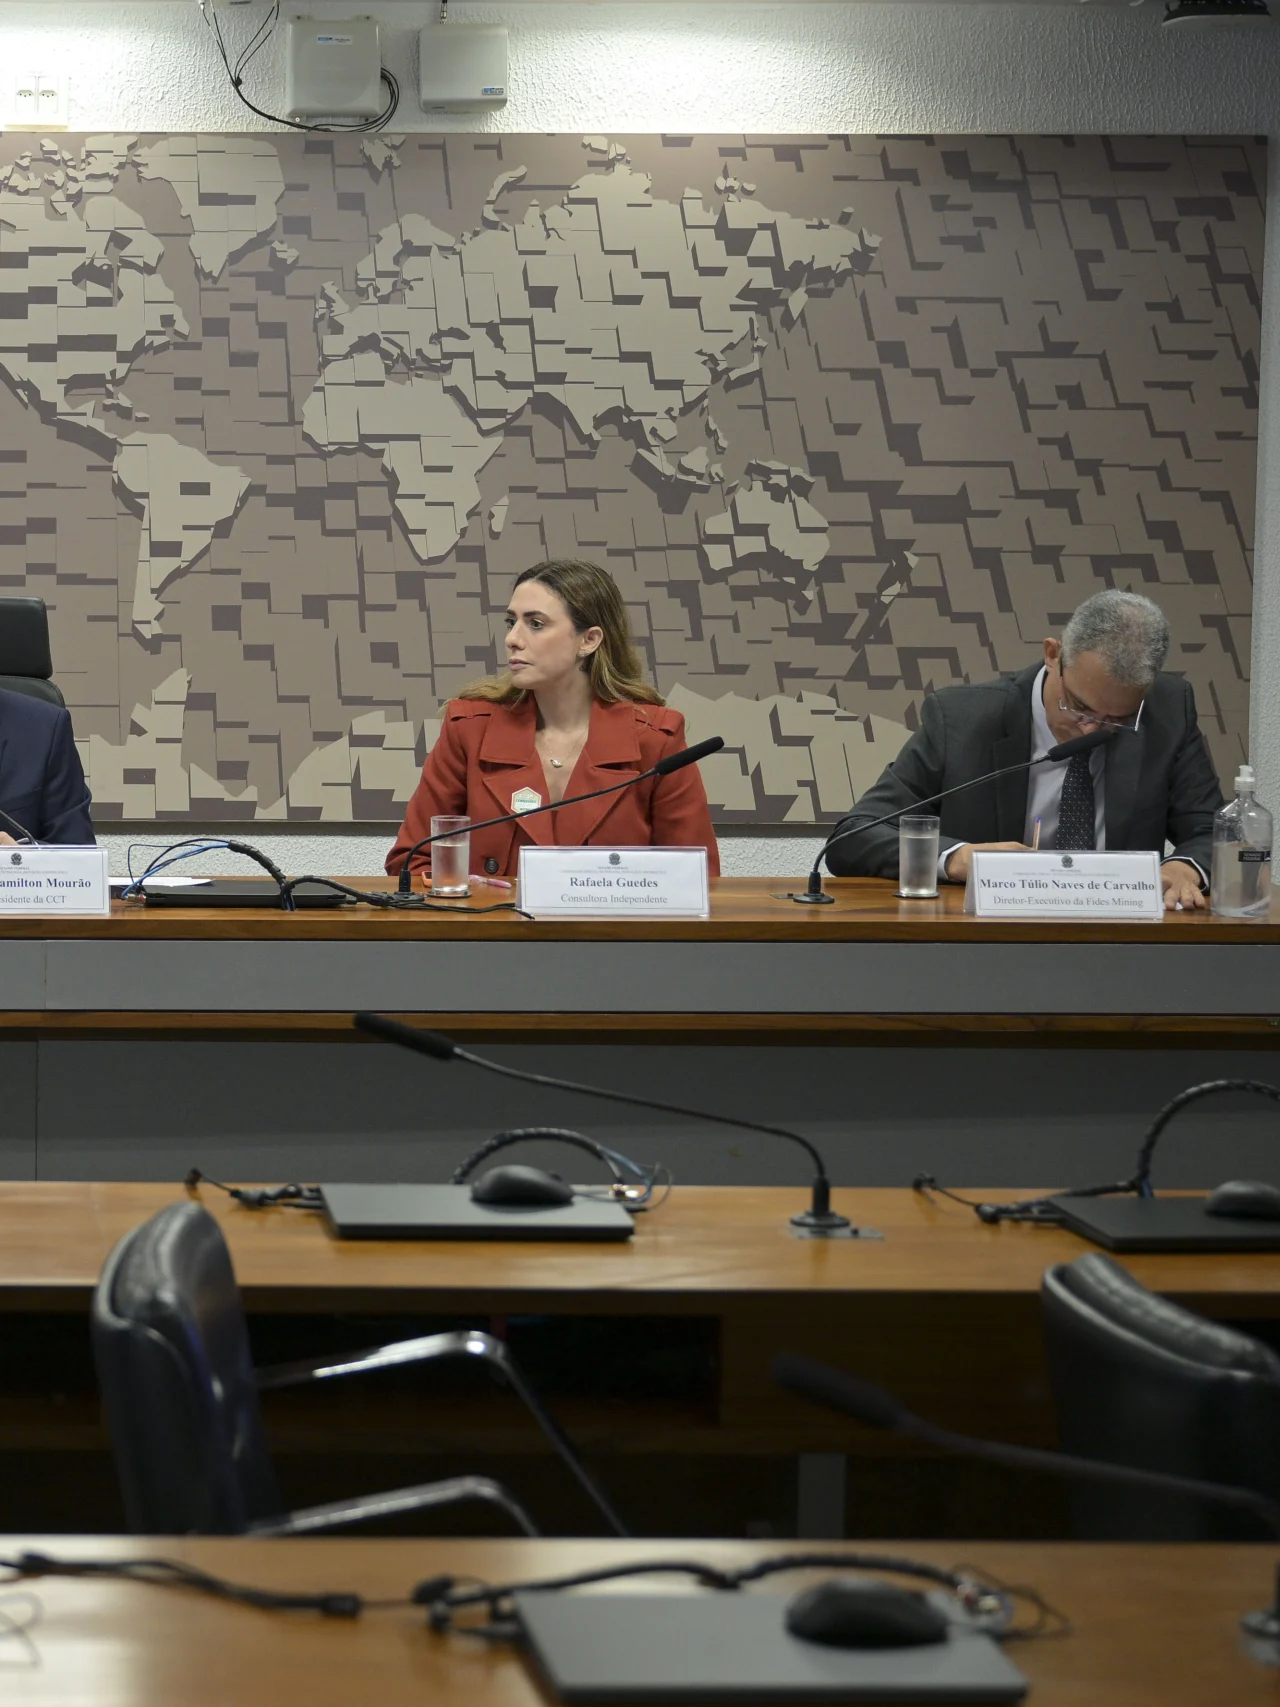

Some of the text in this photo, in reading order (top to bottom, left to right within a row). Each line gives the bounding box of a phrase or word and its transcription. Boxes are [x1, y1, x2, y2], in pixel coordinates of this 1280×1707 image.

[46, 878, 92, 888] Mourão
[570, 877, 658, 888] Rafaela Guedes
[980, 878, 1155, 891] Marco Túlio Naves de Carvalho
[33, 894, 43, 904] da
[45, 895, 67, 904] CCT
[561, 894, 668, 905] Consultora Independente
[993, 895, 1071, 905] Diretor-Executivo
[1073, 897, 1084, 906] da
[1112, 897, 1144, 908] Mining
